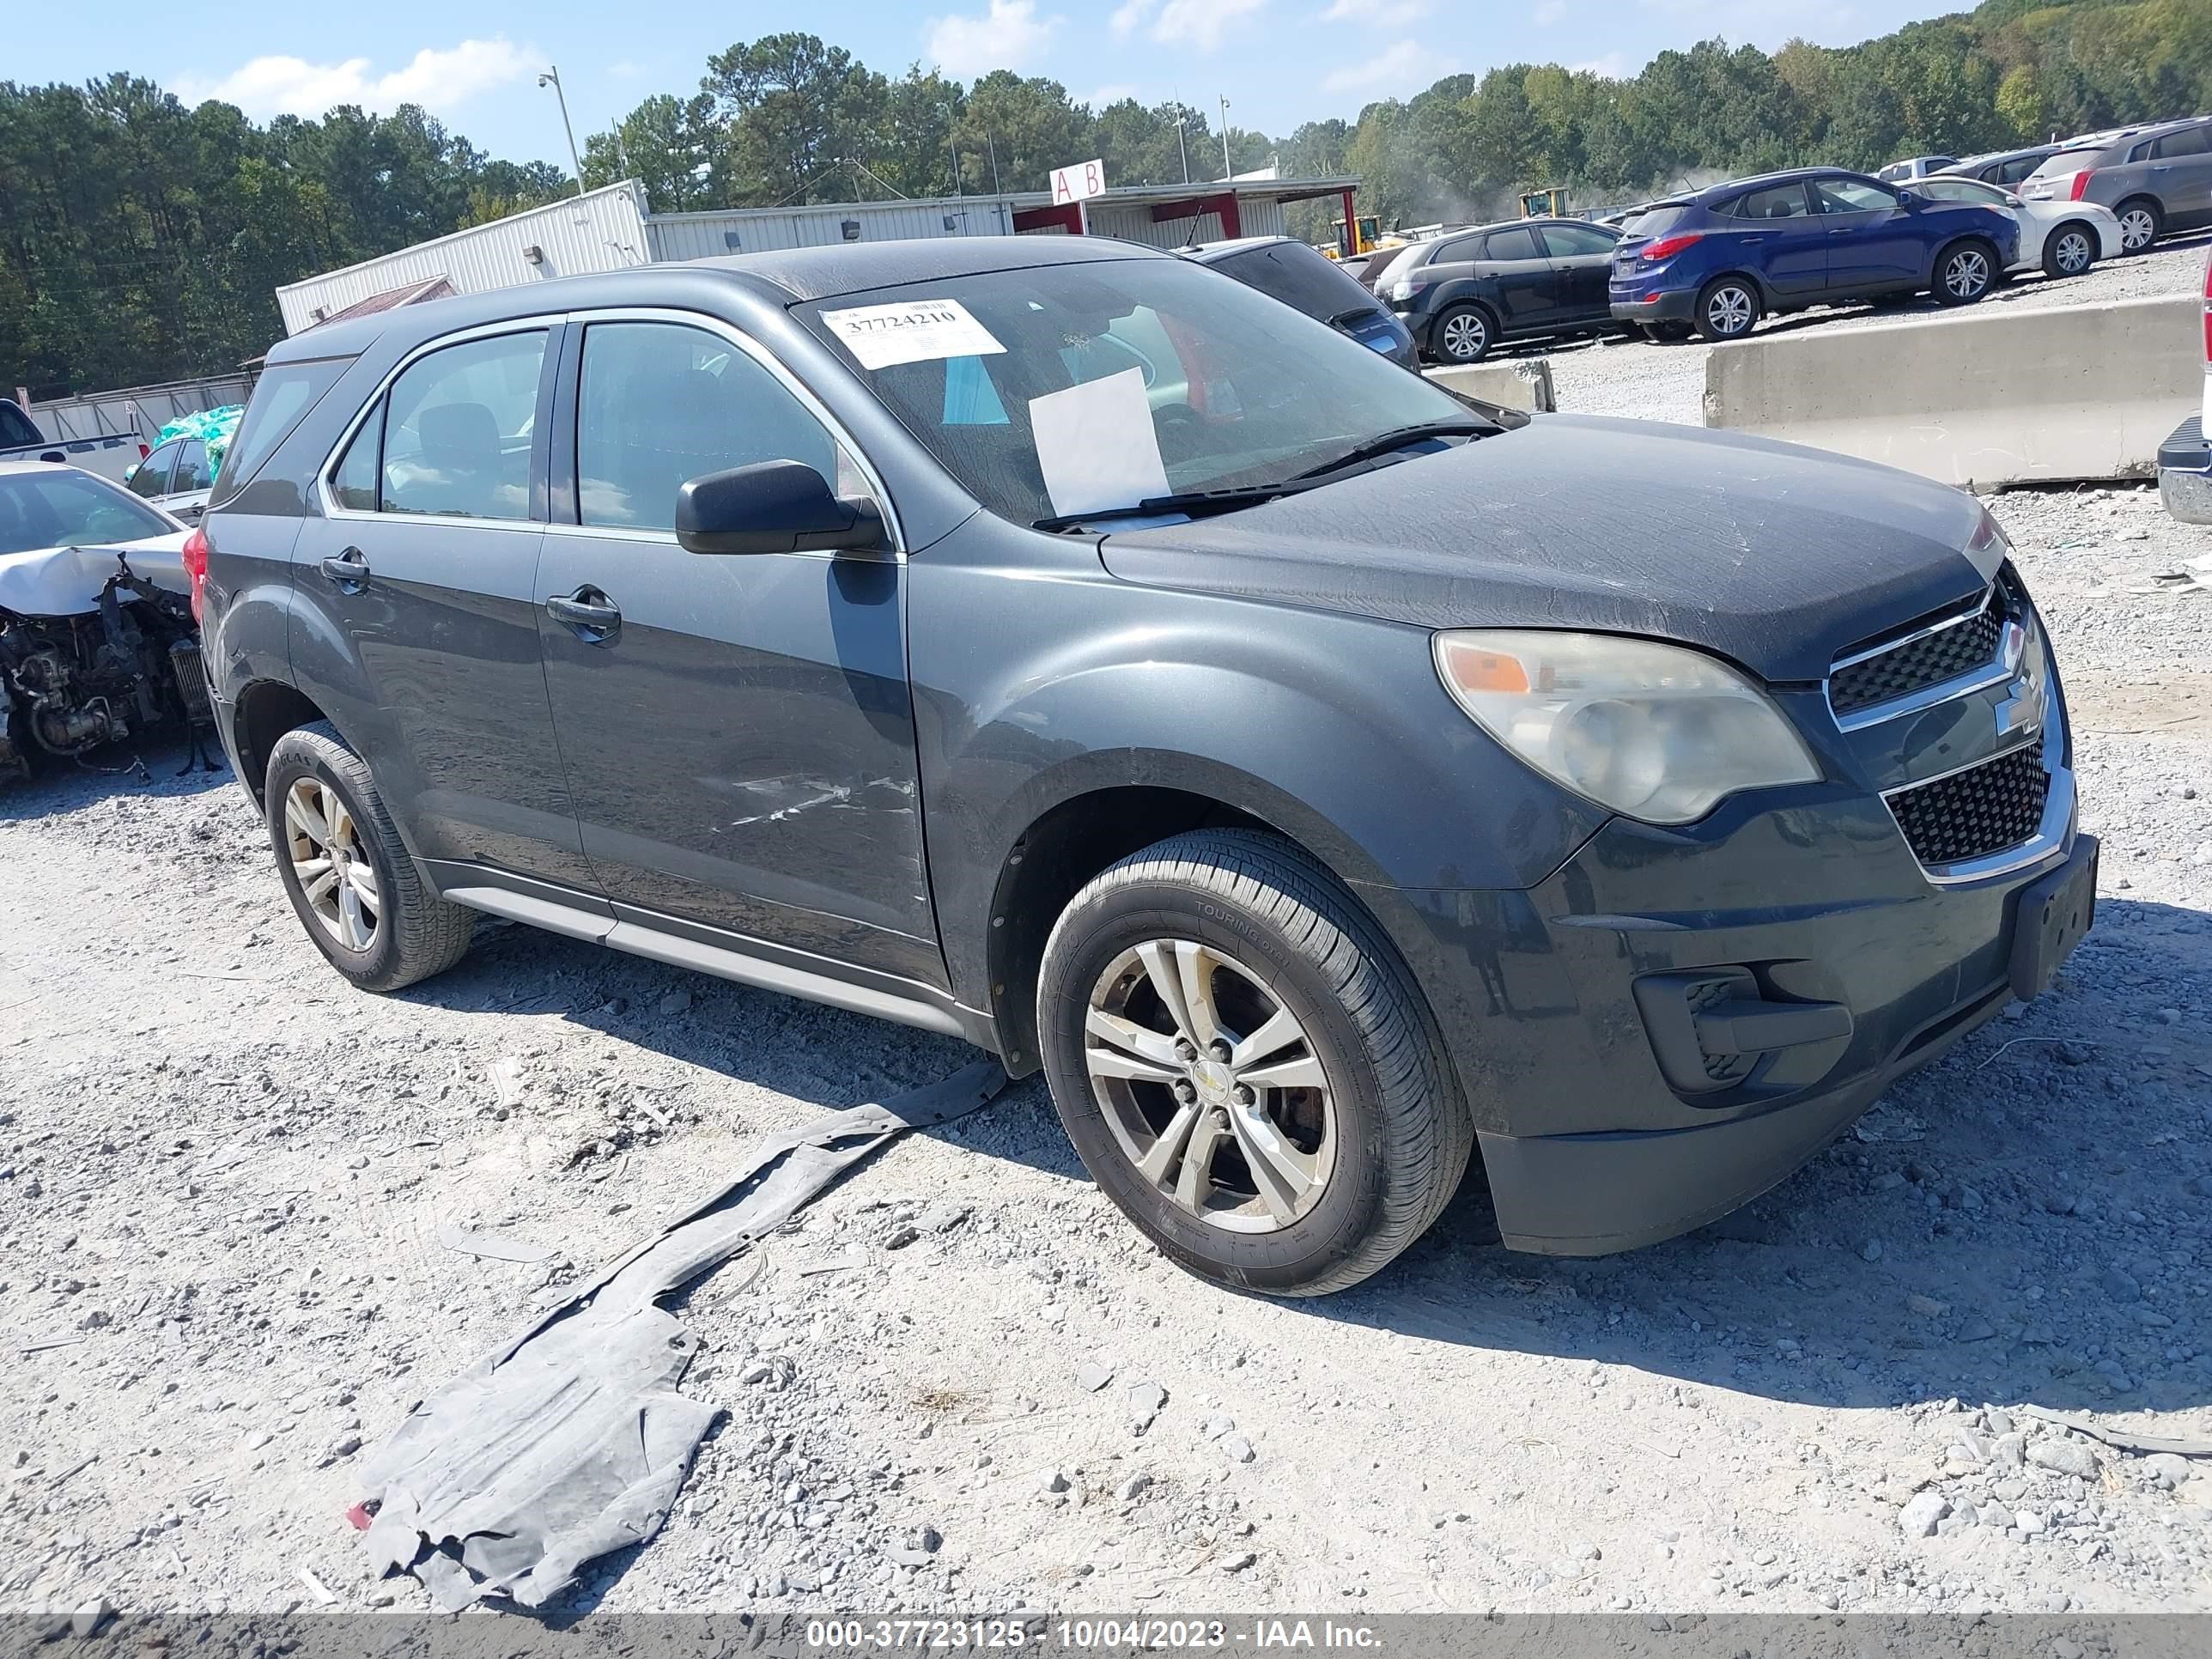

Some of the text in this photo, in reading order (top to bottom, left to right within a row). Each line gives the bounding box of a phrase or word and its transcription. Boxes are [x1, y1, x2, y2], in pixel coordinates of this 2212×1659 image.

[1057, 163, 1099, 203] A B
[845, 311, 957, 333] 37724210
[1194, 900, 1261, 943] TOURING
